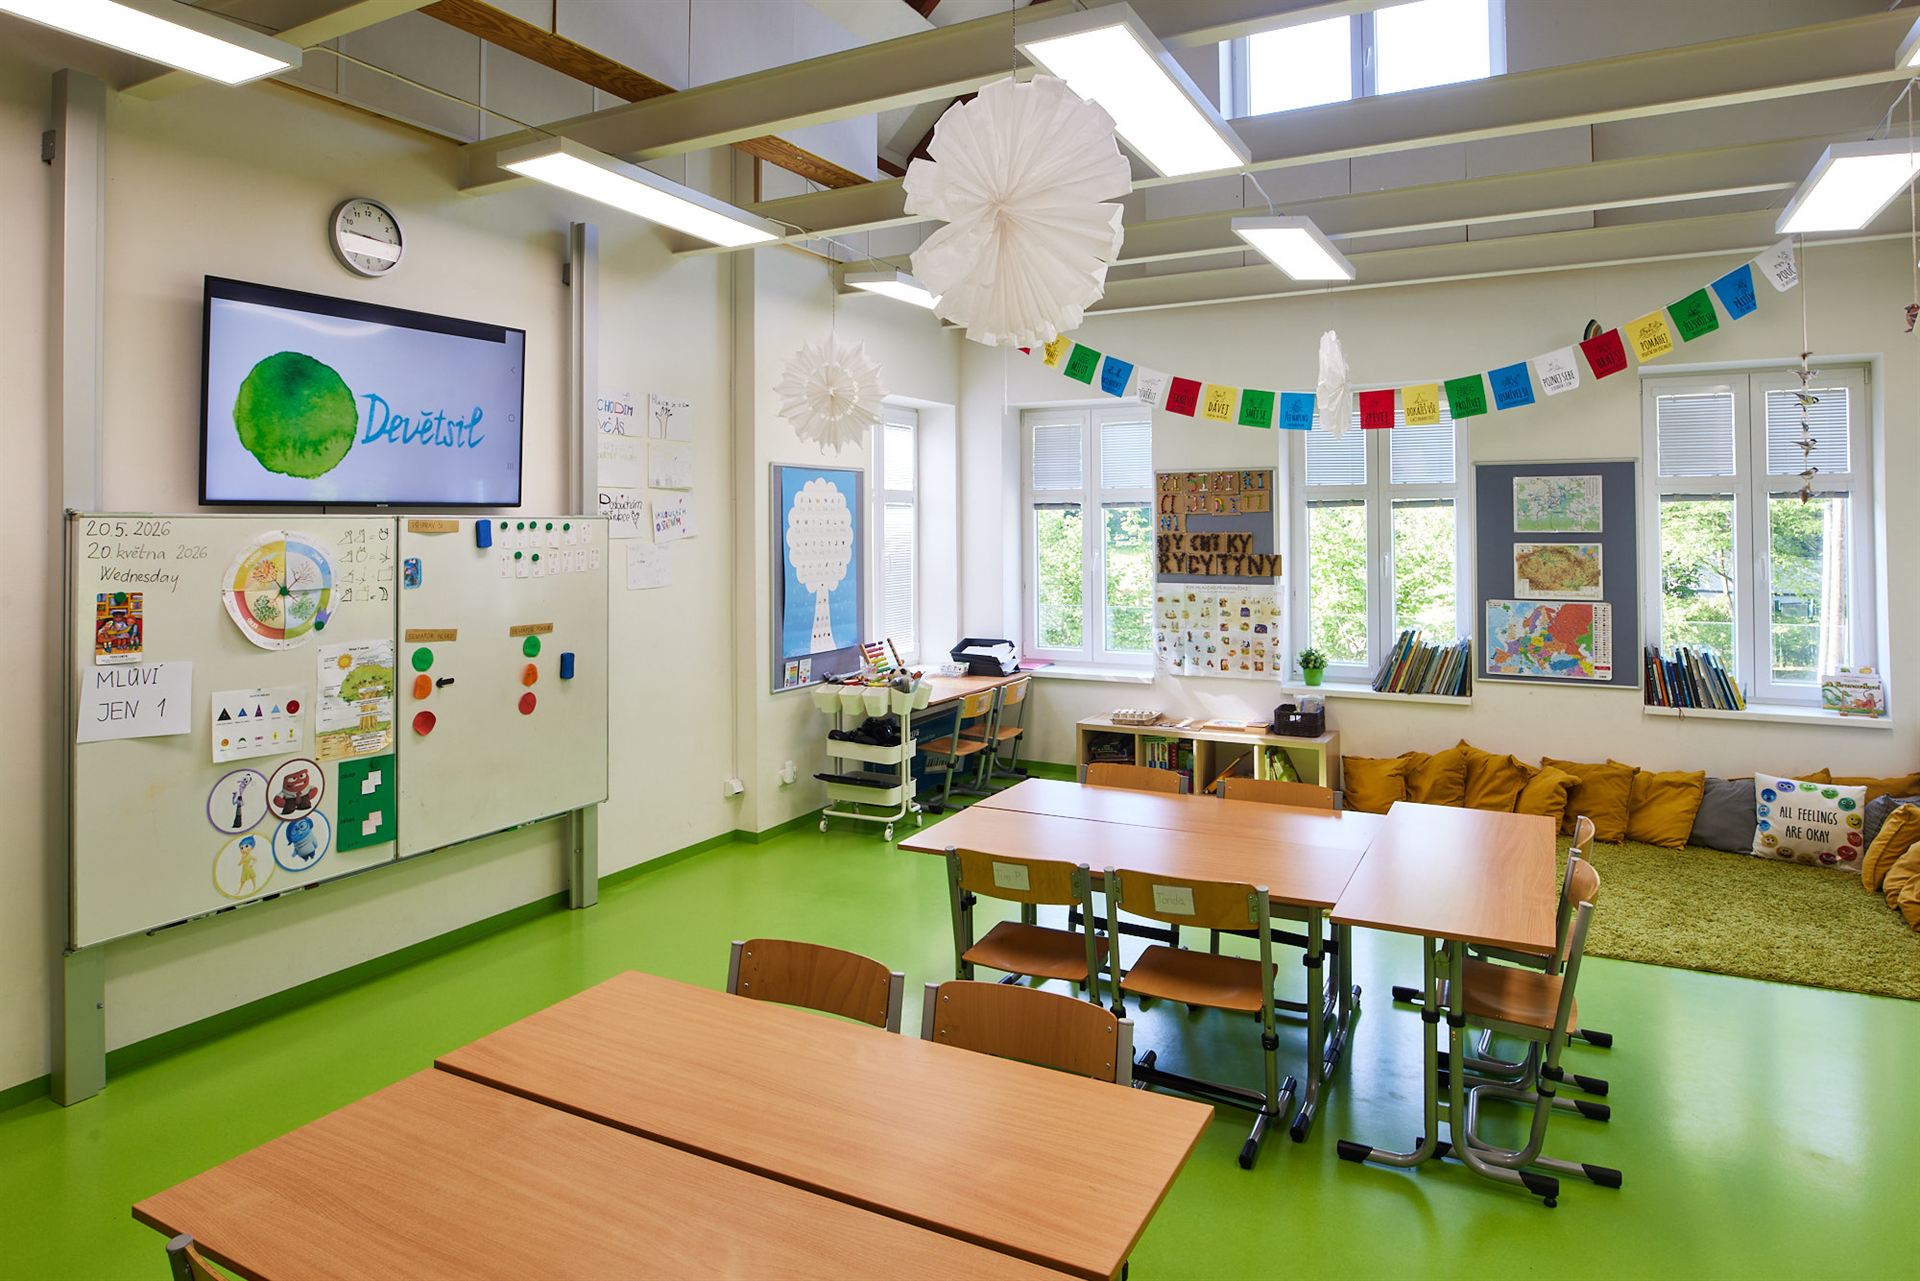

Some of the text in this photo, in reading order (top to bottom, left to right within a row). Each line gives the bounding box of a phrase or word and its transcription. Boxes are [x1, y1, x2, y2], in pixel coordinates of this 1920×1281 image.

[1208, 400, 1230, 416] DÁVEJ
[358, 393, 485, 448] Devětsil
[133, 520, 171, 537] 2026
[116, 543, 166, 560] května
[175, 544, 208, 559] 2026
[1247, 554, 1279, 576] NY
[100, 564, 180, 593] Wednesday
[97, 698, 166, 722] JEN 1
[1780, 806, 1838, 825] ALL FEELINGS
[1785, 826, 1830, 843] ARE OKAY
